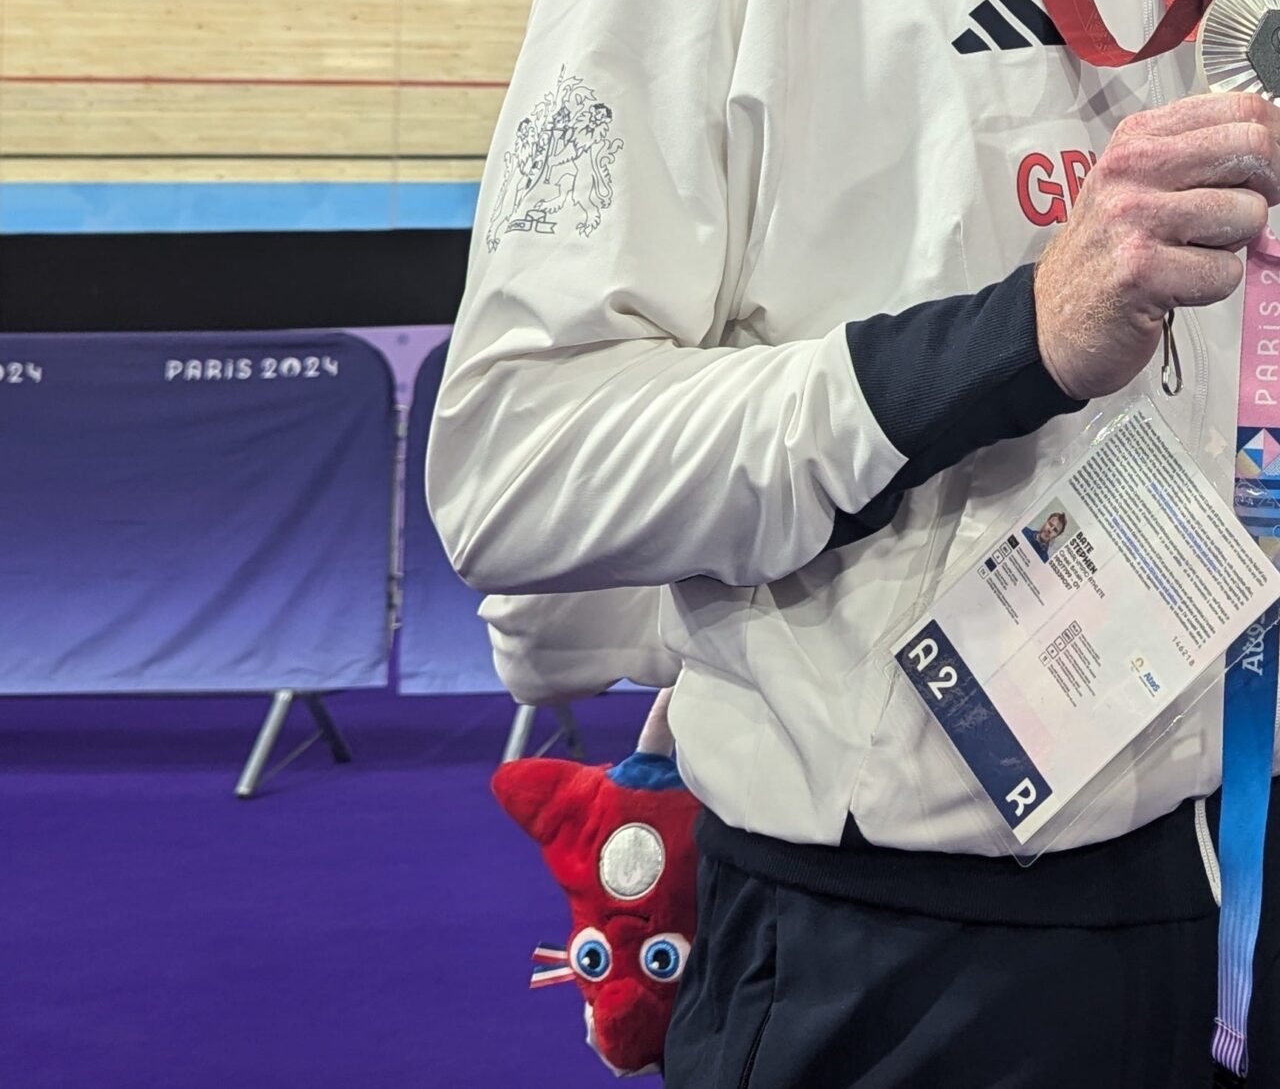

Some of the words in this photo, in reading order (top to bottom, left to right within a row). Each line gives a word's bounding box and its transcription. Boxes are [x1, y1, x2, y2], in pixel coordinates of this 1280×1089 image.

[260, 355, 339, 379] 2024
[1070, 538, 1098, 574] STEPHEN
[1076, 531, 1094, 554] BATE
[1004, 777, 1037, 817] R
